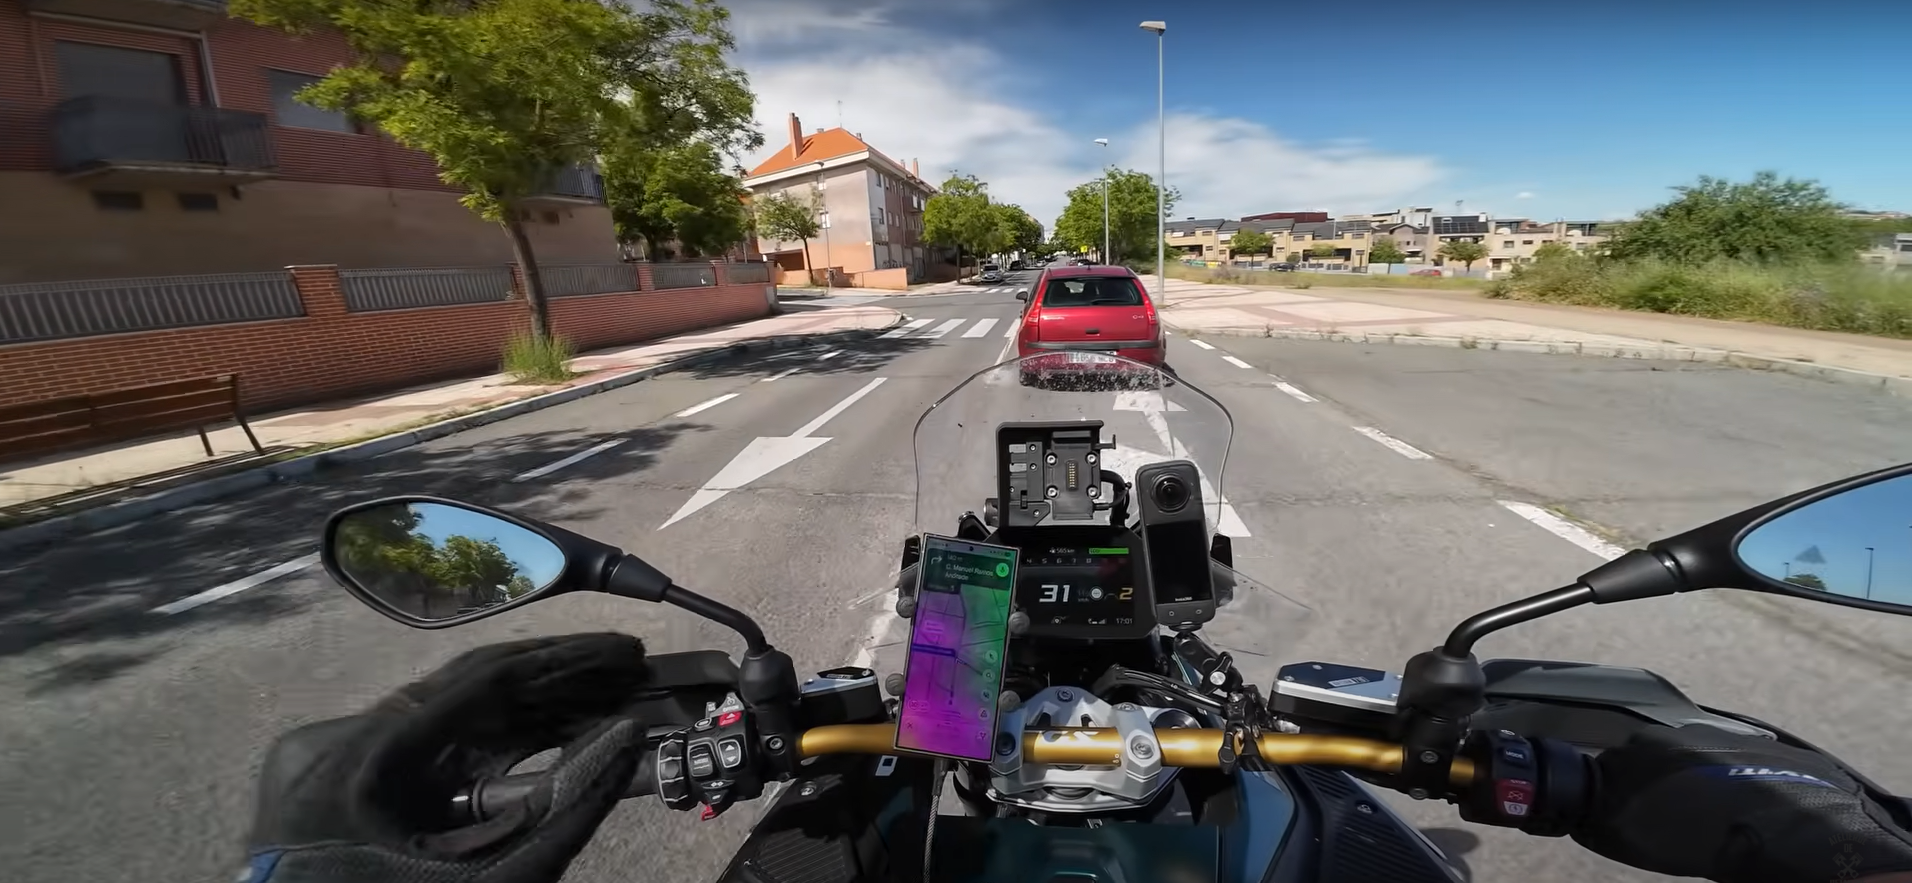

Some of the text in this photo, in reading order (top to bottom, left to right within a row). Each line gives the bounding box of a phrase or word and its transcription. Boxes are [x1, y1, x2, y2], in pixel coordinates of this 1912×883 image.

[945, 572, 969, 581] Andrade
[953, 564, 974, 573] Manuel
[974, 567, 994, 577] Ramos
[1038, 584, 1071, 603] 31
[1119, 587, 1134, 600] 2
